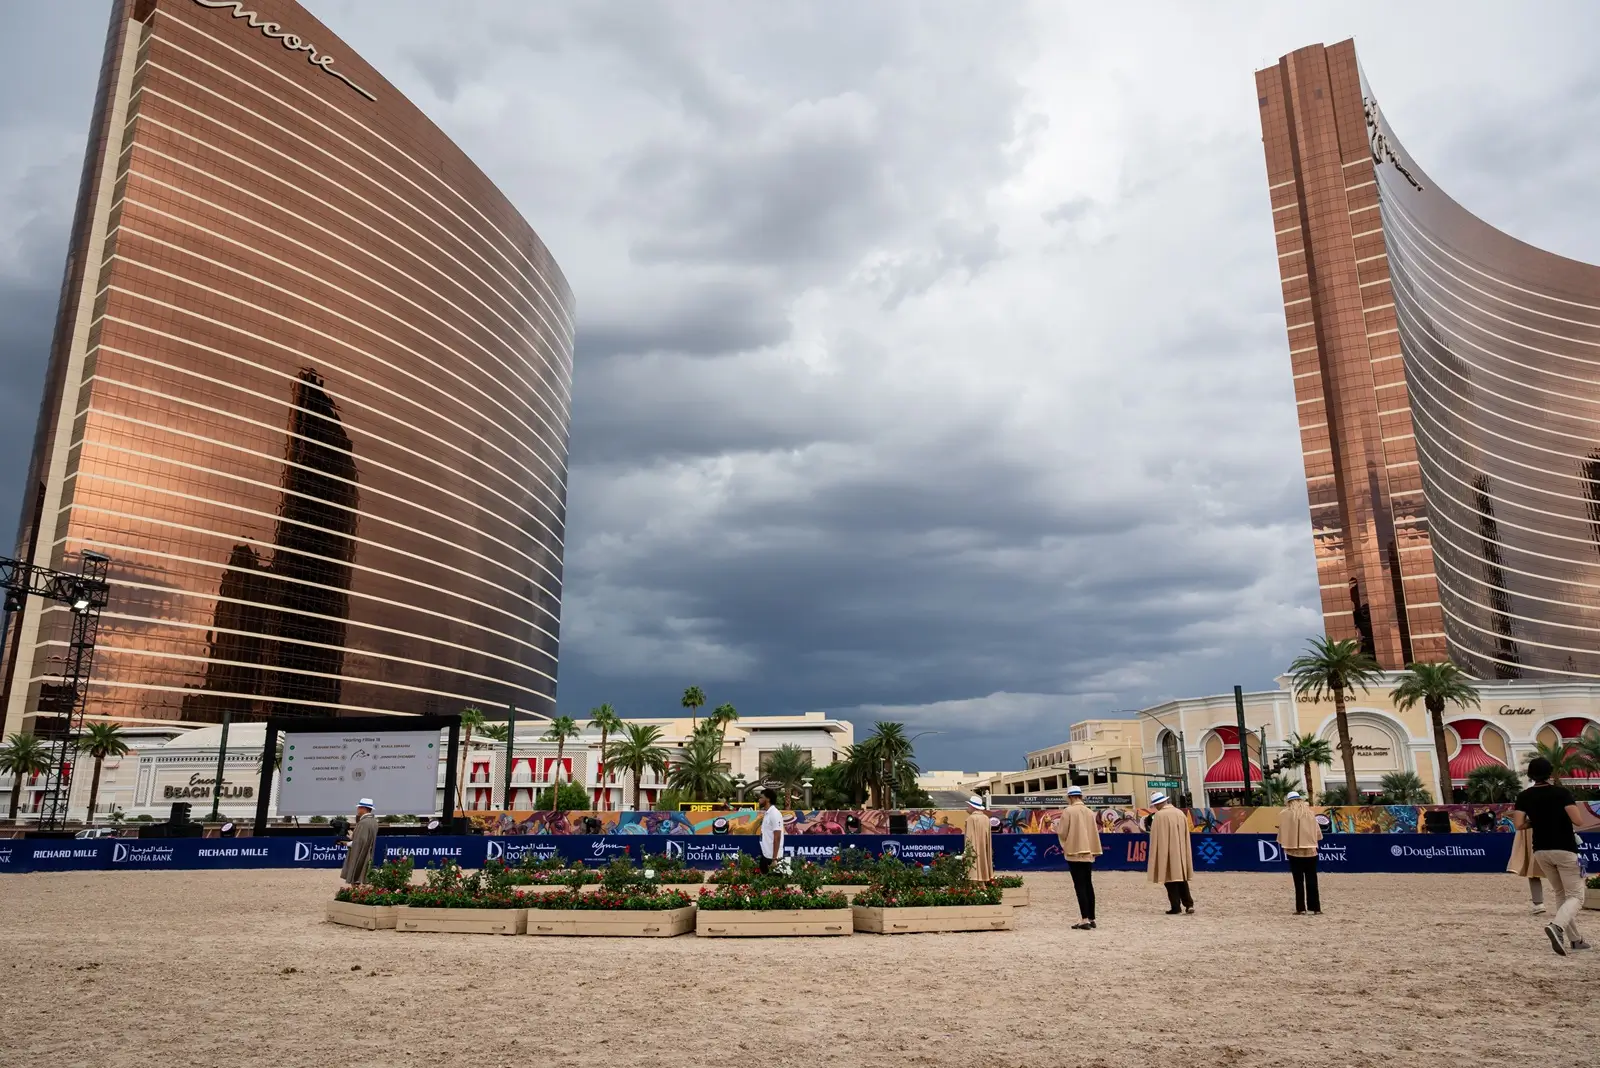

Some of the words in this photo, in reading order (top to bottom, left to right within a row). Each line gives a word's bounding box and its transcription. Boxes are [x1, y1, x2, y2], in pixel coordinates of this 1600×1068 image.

[195, 0, 377, 102] ncore
[1499, 704, 1536, 715] Cartier
[164, 785, 210, 798] BEACH
[33, 850, 71, 858] RICHARD
[387, 848, 429, 856] RICHARD
[1127, 841, 1147, 862] LAS
[1318, 853, 1347, 861] BANK
[1403, 846, 1485, 858] DouglasElliman
